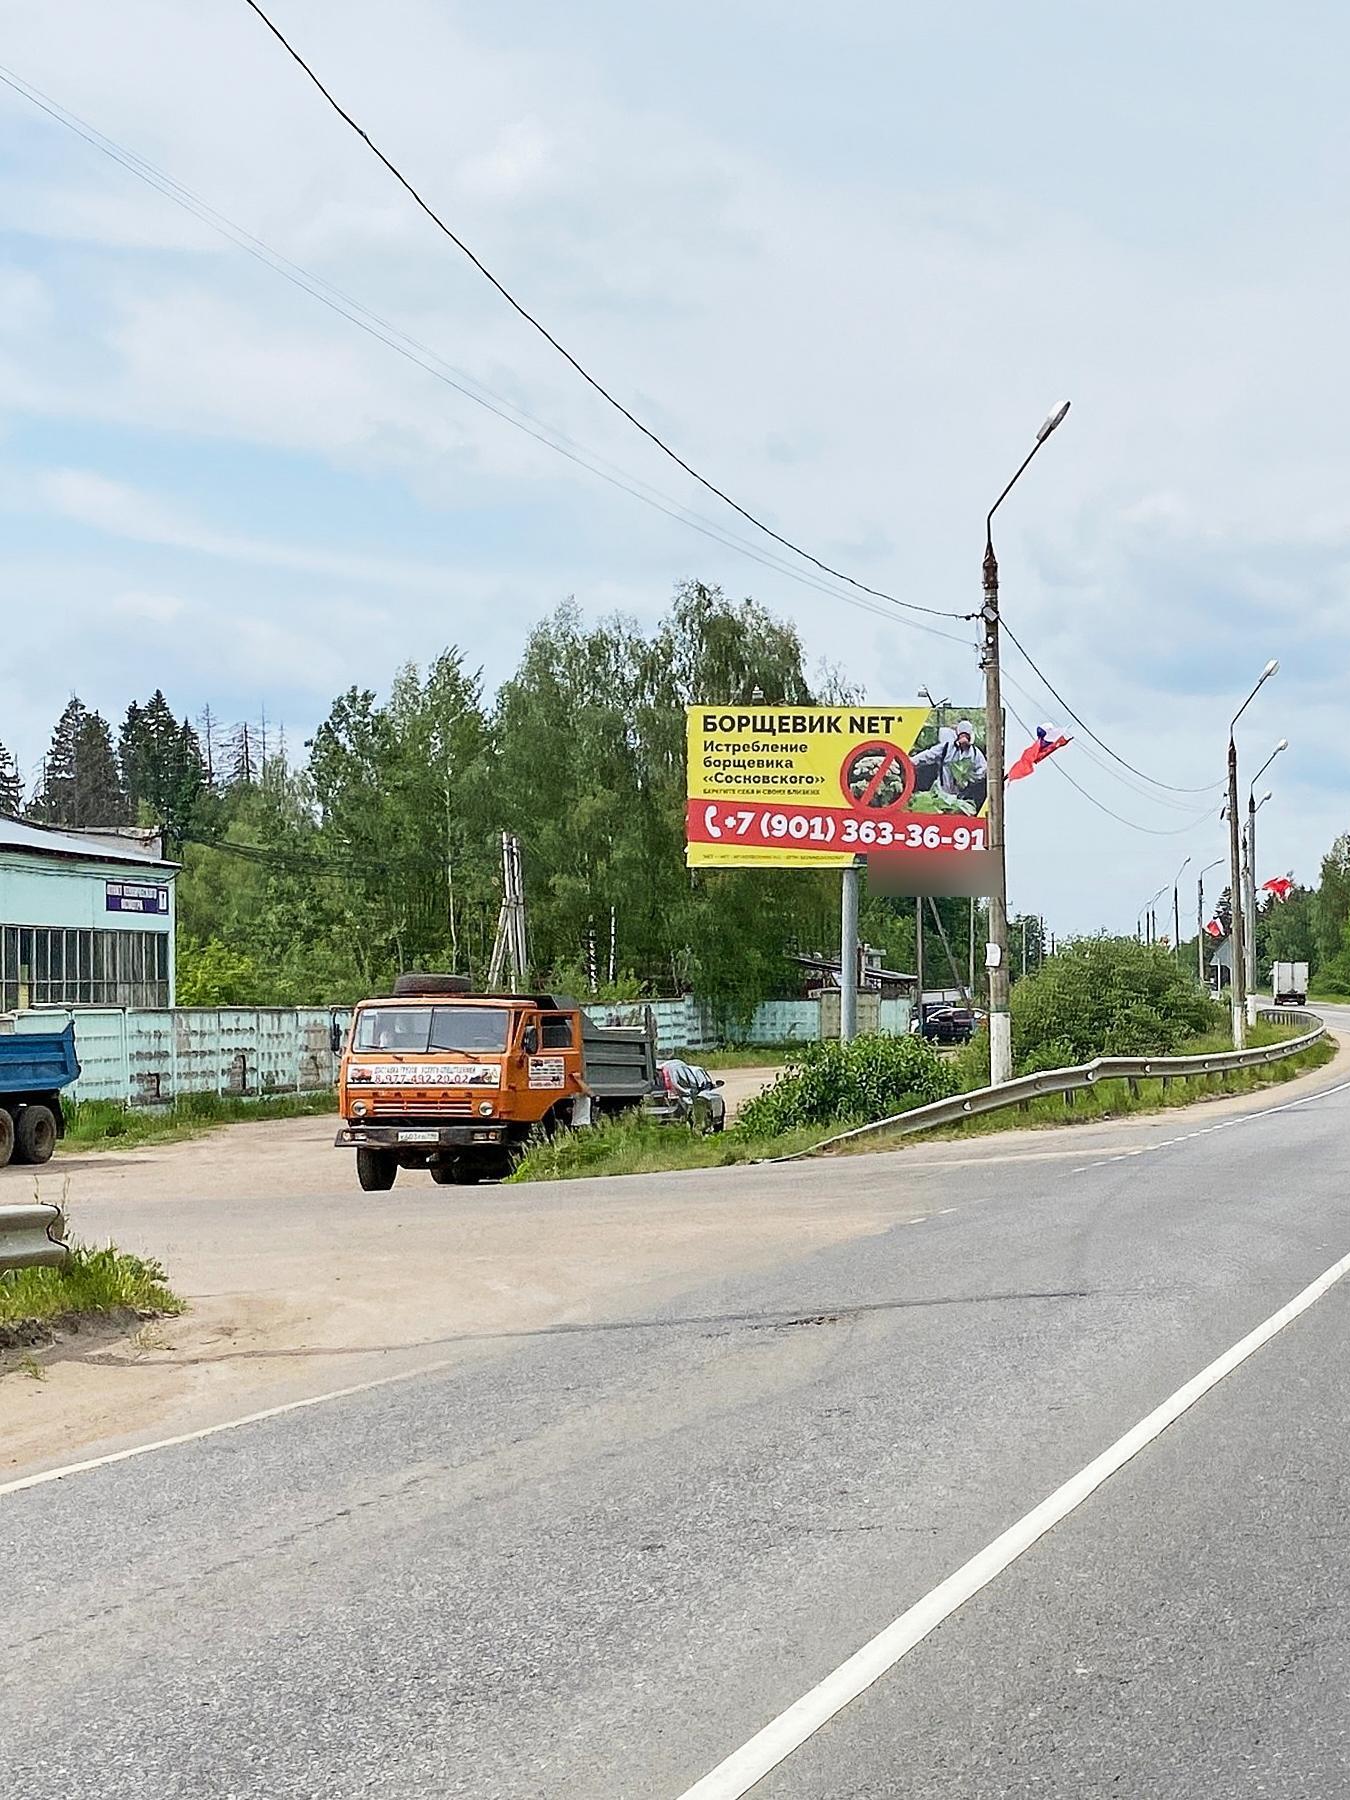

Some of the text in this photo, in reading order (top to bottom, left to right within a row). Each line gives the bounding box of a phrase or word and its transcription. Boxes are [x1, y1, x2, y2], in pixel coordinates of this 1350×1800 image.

[702, 715, 843, 737] БОРЩЕВИК
[703, 740, 808, 755] Истребление
[703, 756, 794, 770] борщевика
[703, 772, 825, 785] «Сосновского»
[724, 811, 986, 851] +7 (901) 363-36-91
